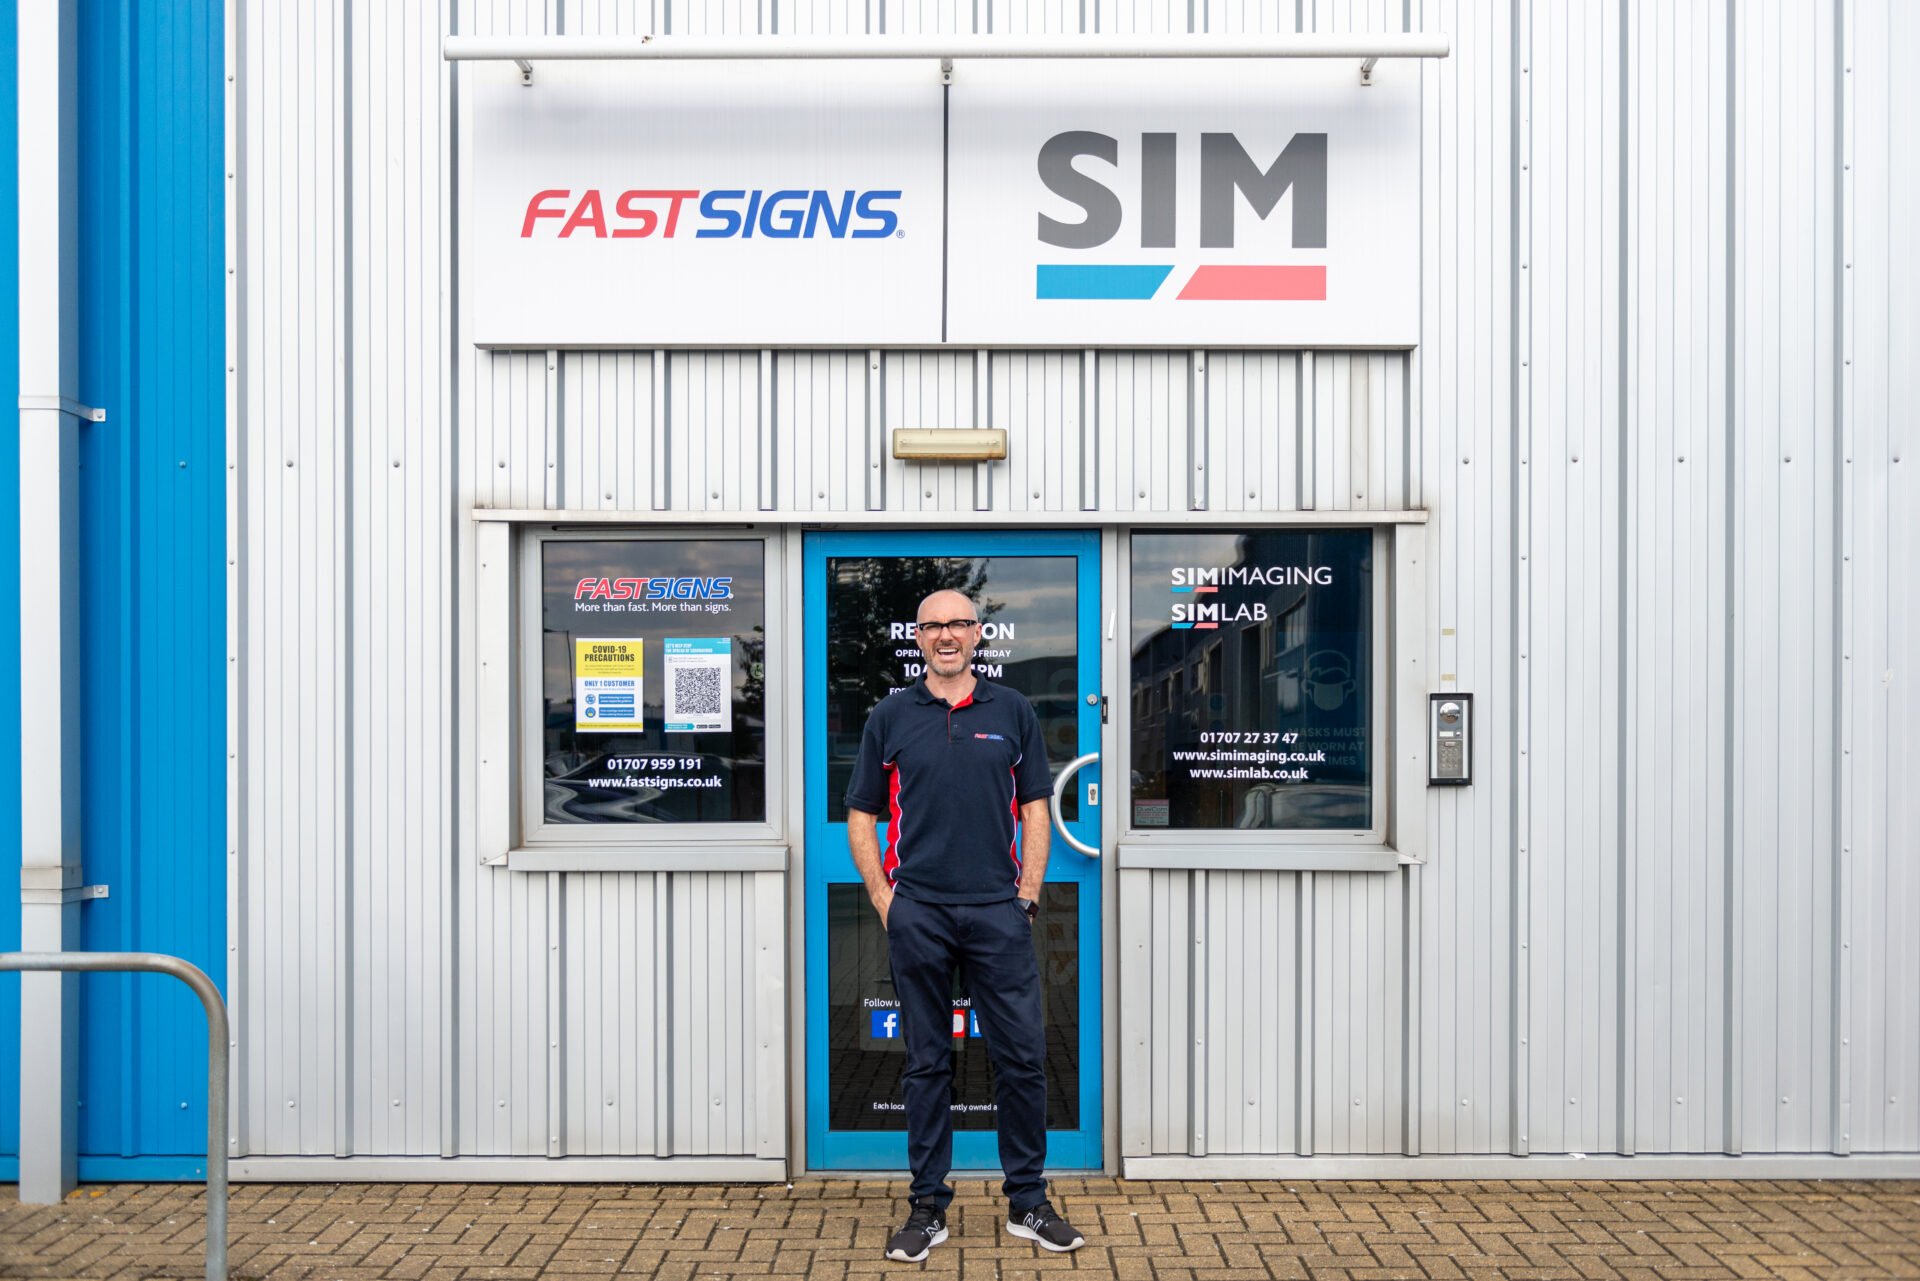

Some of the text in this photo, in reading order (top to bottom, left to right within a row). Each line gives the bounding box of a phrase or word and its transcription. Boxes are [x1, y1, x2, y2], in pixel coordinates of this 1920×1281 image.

[1037, 130, 1328, 249] SIM
[575, 602, 732, 615] More than fast. More than signs.
[1171, 603, 1268, 622] SIMLAB
[592, 645, 627, 654] COVID-19
[895, 649, 920, 658] OPEN
[978, 649, 1012, 658] FRIDAY
[584, 653, 635, 662] PRECAUTIONS
[1200, 732, 1299, 744] 01707 27 37 47
[1173, 749, 1326, 765] www.simimaging.co.uk
[607, 758, 702, 770] 01707 959 191
[1189, 766, 1309, 779] www.simlab.co.uk
[588, 775, 722, 790] www.fastsigns.co.uk
[864, 997, 893, 1007] Follow
[895, 999, 901, 1007] u
[873, 1102, 889, 1111] Each
[968, 1103, 990, 1112] owned
